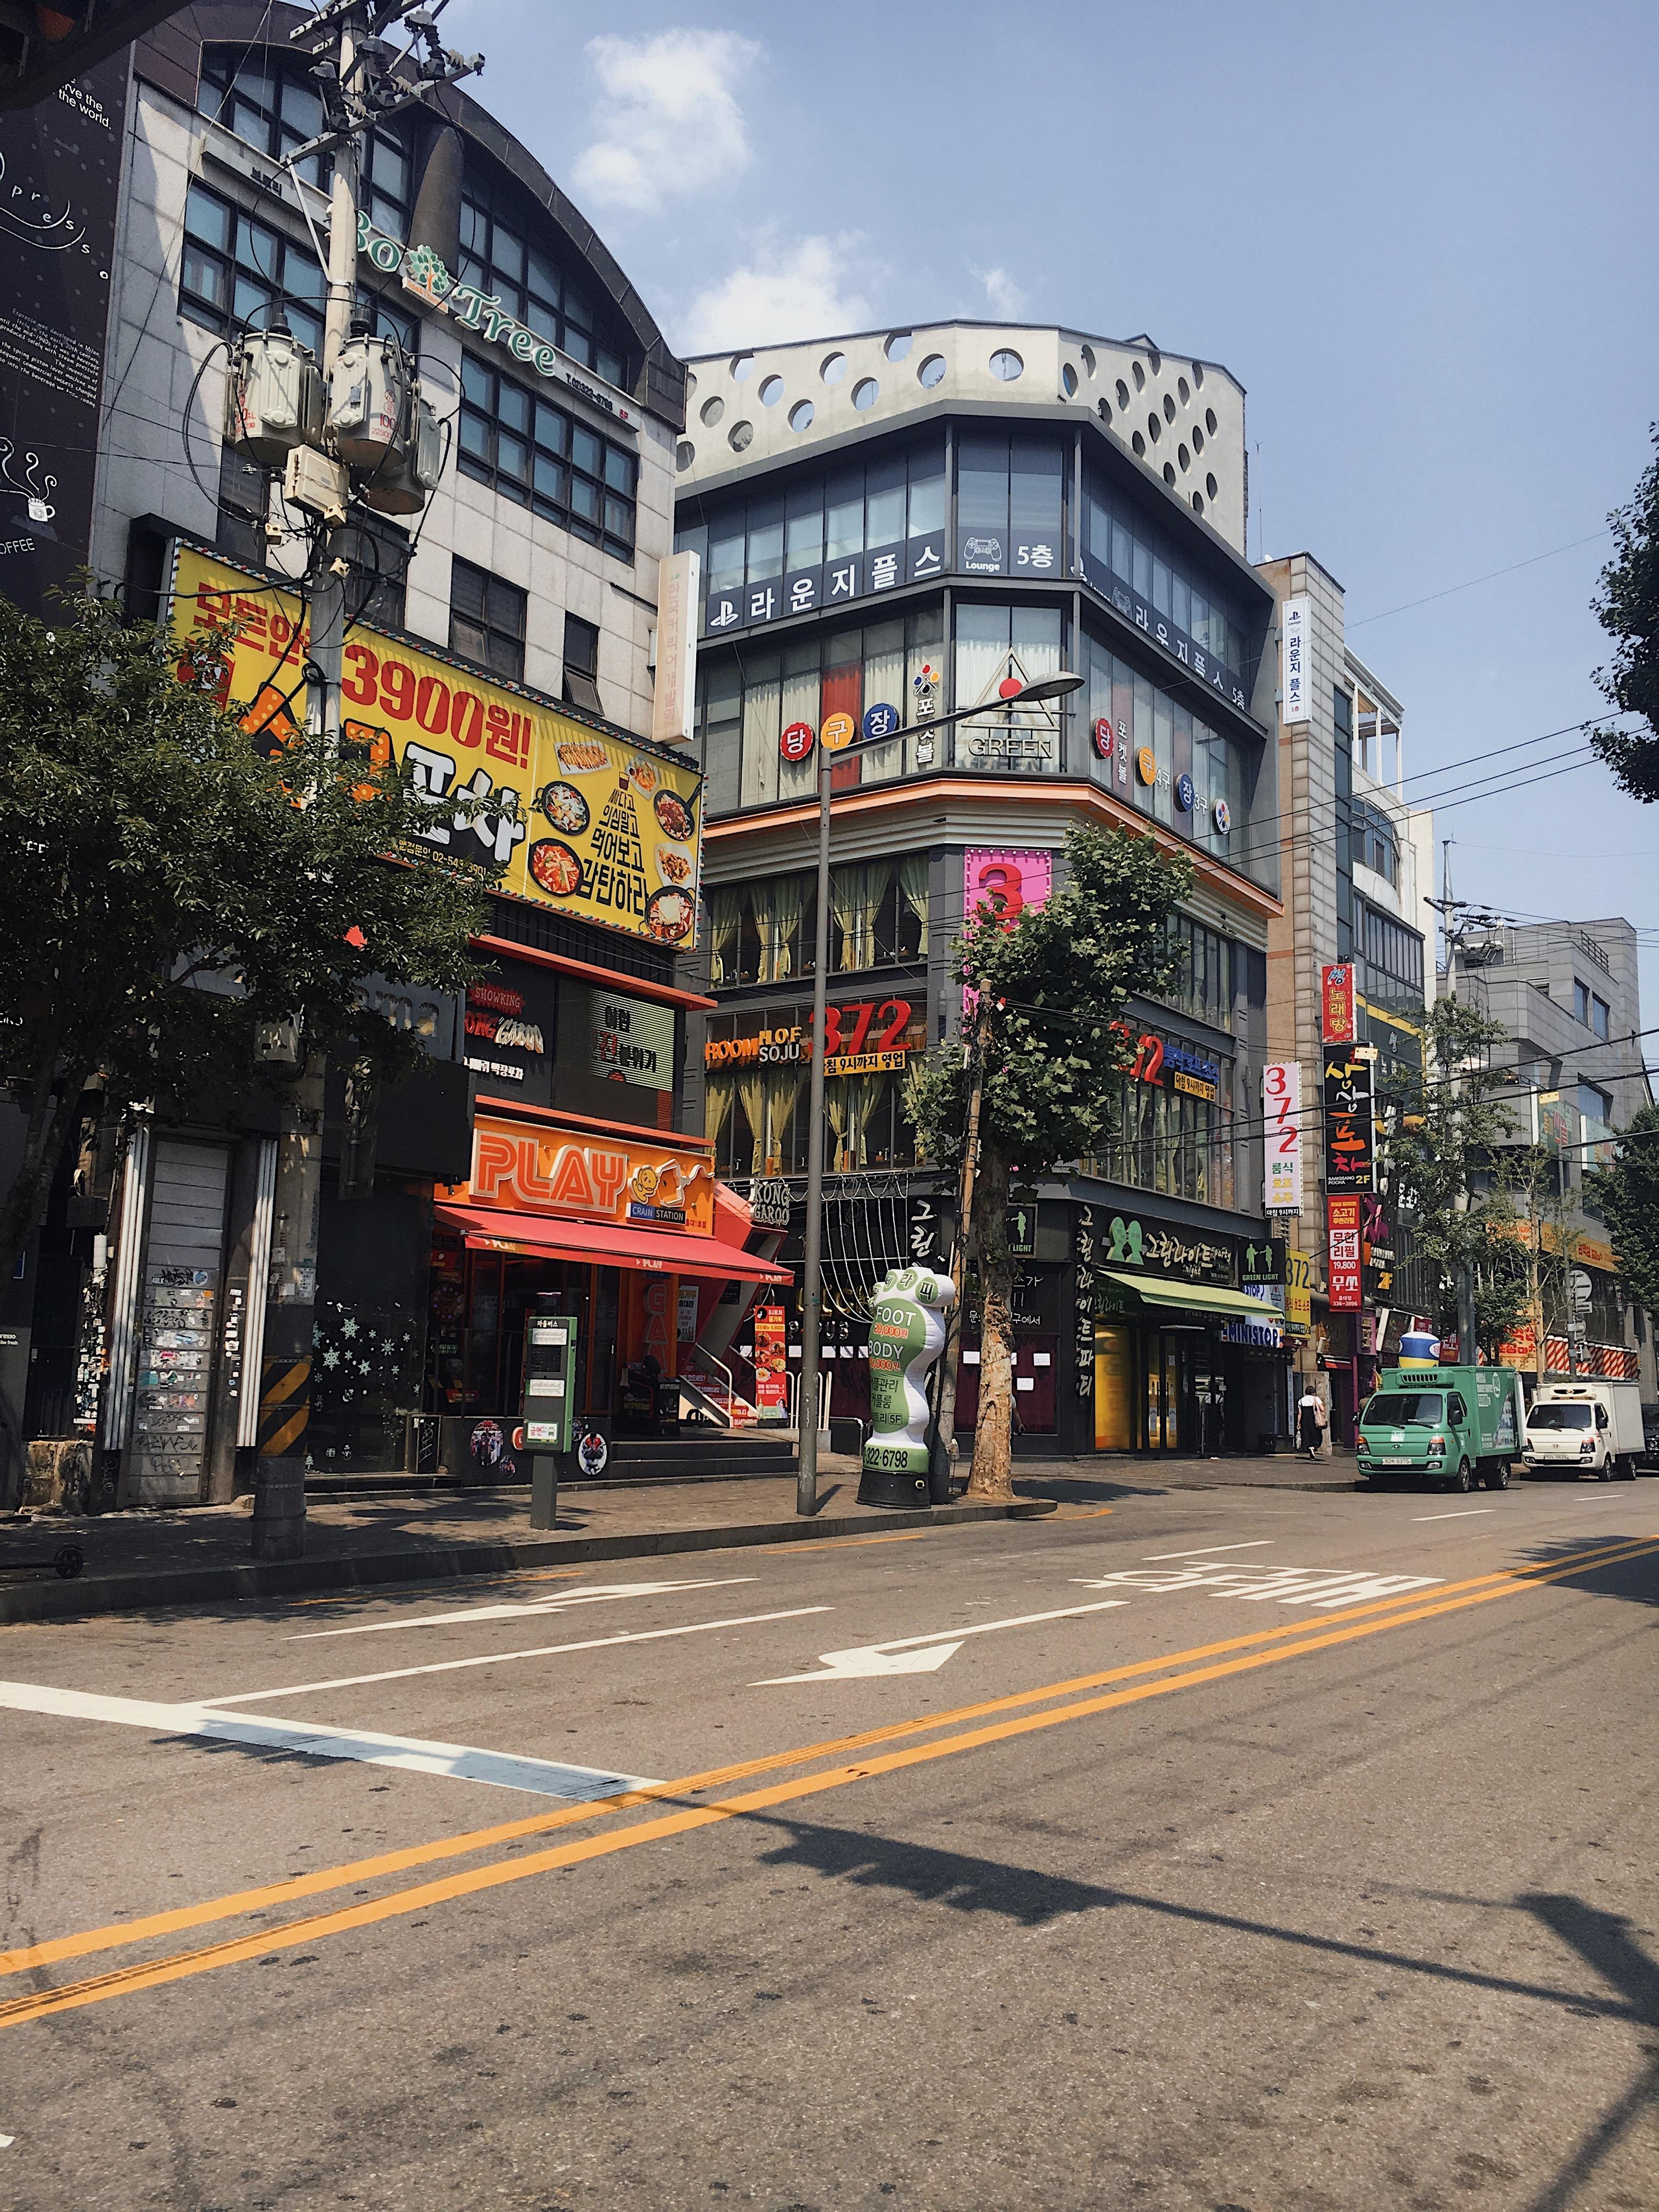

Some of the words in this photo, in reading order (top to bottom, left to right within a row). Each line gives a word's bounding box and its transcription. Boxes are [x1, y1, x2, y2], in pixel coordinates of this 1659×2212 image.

[58, 89, 76, 107] the
[79, 104, 111, 130] world.
[86, 94, 103, 112] the
[12, 308, 36, 324] Espresso
[38, 322, 48, 331] was
[50, 328, 76, 345] developed
[17, 318, 30, 331] Italy
[50, 336, 64, 347] early
[65, 342, 78, 353] 20th
[452, 284, 557, 377] Tree
[0, 325, 25, 340] produced
[27, 337, 43, 351] solely
[45, 346, 56, 356] with
[58, 353, 75, 365] steam
[76, 362, 99, 377] pressure
[23, 329, 51, 347] mid-1940s
[60, 347, 69, 356] was
[76, 355, 100, 371] beverage
[1, 341, 11, 350] the
[13, 347, 30, 360] spring
[31, 356, 49, 368] piston
[50, 364, 64, 375] lever
[65, 373, 86, 387] machine
[87, 384, 97, 393] and
[7, 361, 19, 370] into
[20, 367, 30, 376] the
[32, 371, 55, 388] beverage
[23, 360, 52, 378] commercial
[54, 375, 74, 389] success
[75, 386, 97, 400] changed
[54, 358, 65, 369] The
[67, 366, 91, 381] invention
[966, 561, 1000, 572] Lounge
[1017, 544, 1054, 569] 5층
[750, 544, 942, 621] 라운지플스
[1289, 636, 1301, 674] 라운지
[1289, 678, 1301, 704] 플스
[341, 644, 533, 770] 3900원!
[786, 707, 891, 755] 당구장
[968, 736, 1054, 759] GREEN
[1117, 719, 1128, 785] 포켓볼
[1100, 723, 1192, 806] 당구장
[1155, 767, 1171, 791] 4구
[608, 788, 636, 812] 싸다고
[1194, 793, 1209, 815] 3구
[590, 827, 645, 874] 먹어보고
[575, 858, 650, 916] 감탄하라
[474, 986, 521, 1008] SHOWKING
[1329, 987, 1348, 1033] 노래방
[464, 1009, 501, 1039] ONG
[808, 999, 912, 1058] 372
[705, 1037, 760, 1061] ROOM
[759, 1027, 802, 1045] HOF
[759, 1043, 800, 1062] SOJU
[839, 1055, 878, 1071] 9시까지
[881, 1051, 903, 1070] 영업
[1176, 1073, 1186, 1089] 아침
[1187, 1078, 1204, 1095] 9시까지
[1266, 1066, 1298, 1154] 372
[478, 1134, 625, 1208] PLAY
[1271, 1161, 1294, 1175] 룸식
[1355, 1175, 1371, 1184] 2F
[754, 1182, 789, 1208] KONG
[1272, 1177, 1294, 1189] 호프
[1272, 1193, 1294, 1204] 소주
[632, 1205, 653, 1218] CRAIN
[656, 1209, 684, 1221] STATION
[754, 1204, 790, 1226] GAROO
[1266, 1209, 1277, 1218] 아침
[1279, 1207, 1300, 1218] 9시까지
[1332, 1208, 1349, 1217] 소고기
[1146, 1231, 1214, 1268] 그린라이트
[1334, 1231, 1355, 1244] 무한
[642, 1259, 663, 1269] PLAY
[1334, 1245, 1355, 1257] 리필
[1285, 1257, 1310, 1290] 372
[1333, 1261, 1356, 1270] 19,800
[1076, 1205, 1095, 1397] 그린라이트파티
[875, 1305, 917, 1327] FOOT
[1228, 1322, 1279, 1348] MINISTOP
[868, 1339, 905, 1360] BODY
[530, 1426, 542, 1436] 금연
[889, 1415, 902, 1424] 5F
